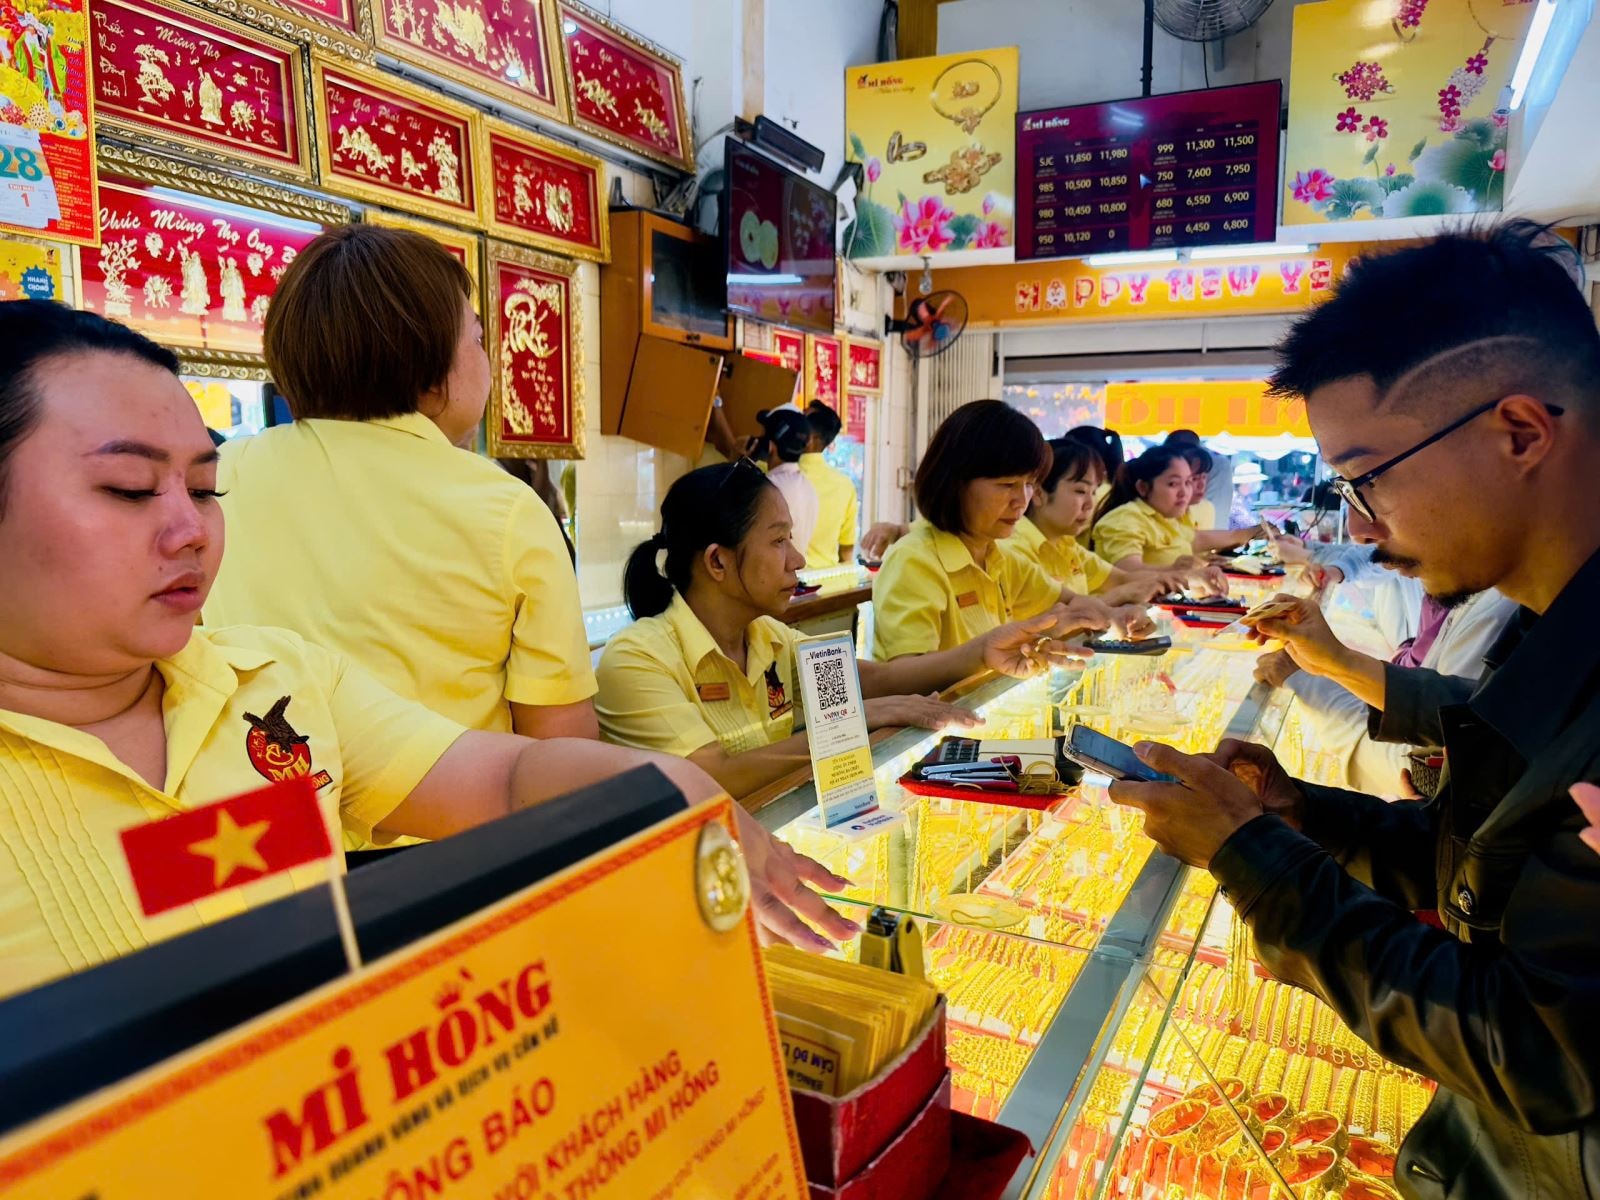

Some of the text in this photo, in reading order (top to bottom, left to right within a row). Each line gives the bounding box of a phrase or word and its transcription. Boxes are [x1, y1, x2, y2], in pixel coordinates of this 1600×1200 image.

[1157, 143, 1174, 154] 999
[1224, 135, 1254, 147] 11,500
[1157, 163, 1250, 181] 750 7,600 7,950
[1186, 194, 1211, 207] 6,550
[1224, 191, 1249, 203] 6,900
[1155, 225, 1172, 235] 610
[1185, 222, 1210, 234] 6,450
[281, 245, 296, 265] B
[1016, 258, 1342, 312] HAPPY NEW YE
[809, 647, 842, 660] VietinBank
[545, 1096, 623, 1180] KHÁCH
[626, 1049, 682, 1112] HÀNG
[372, 1076, 556, 1200] ÔNG BÁO
